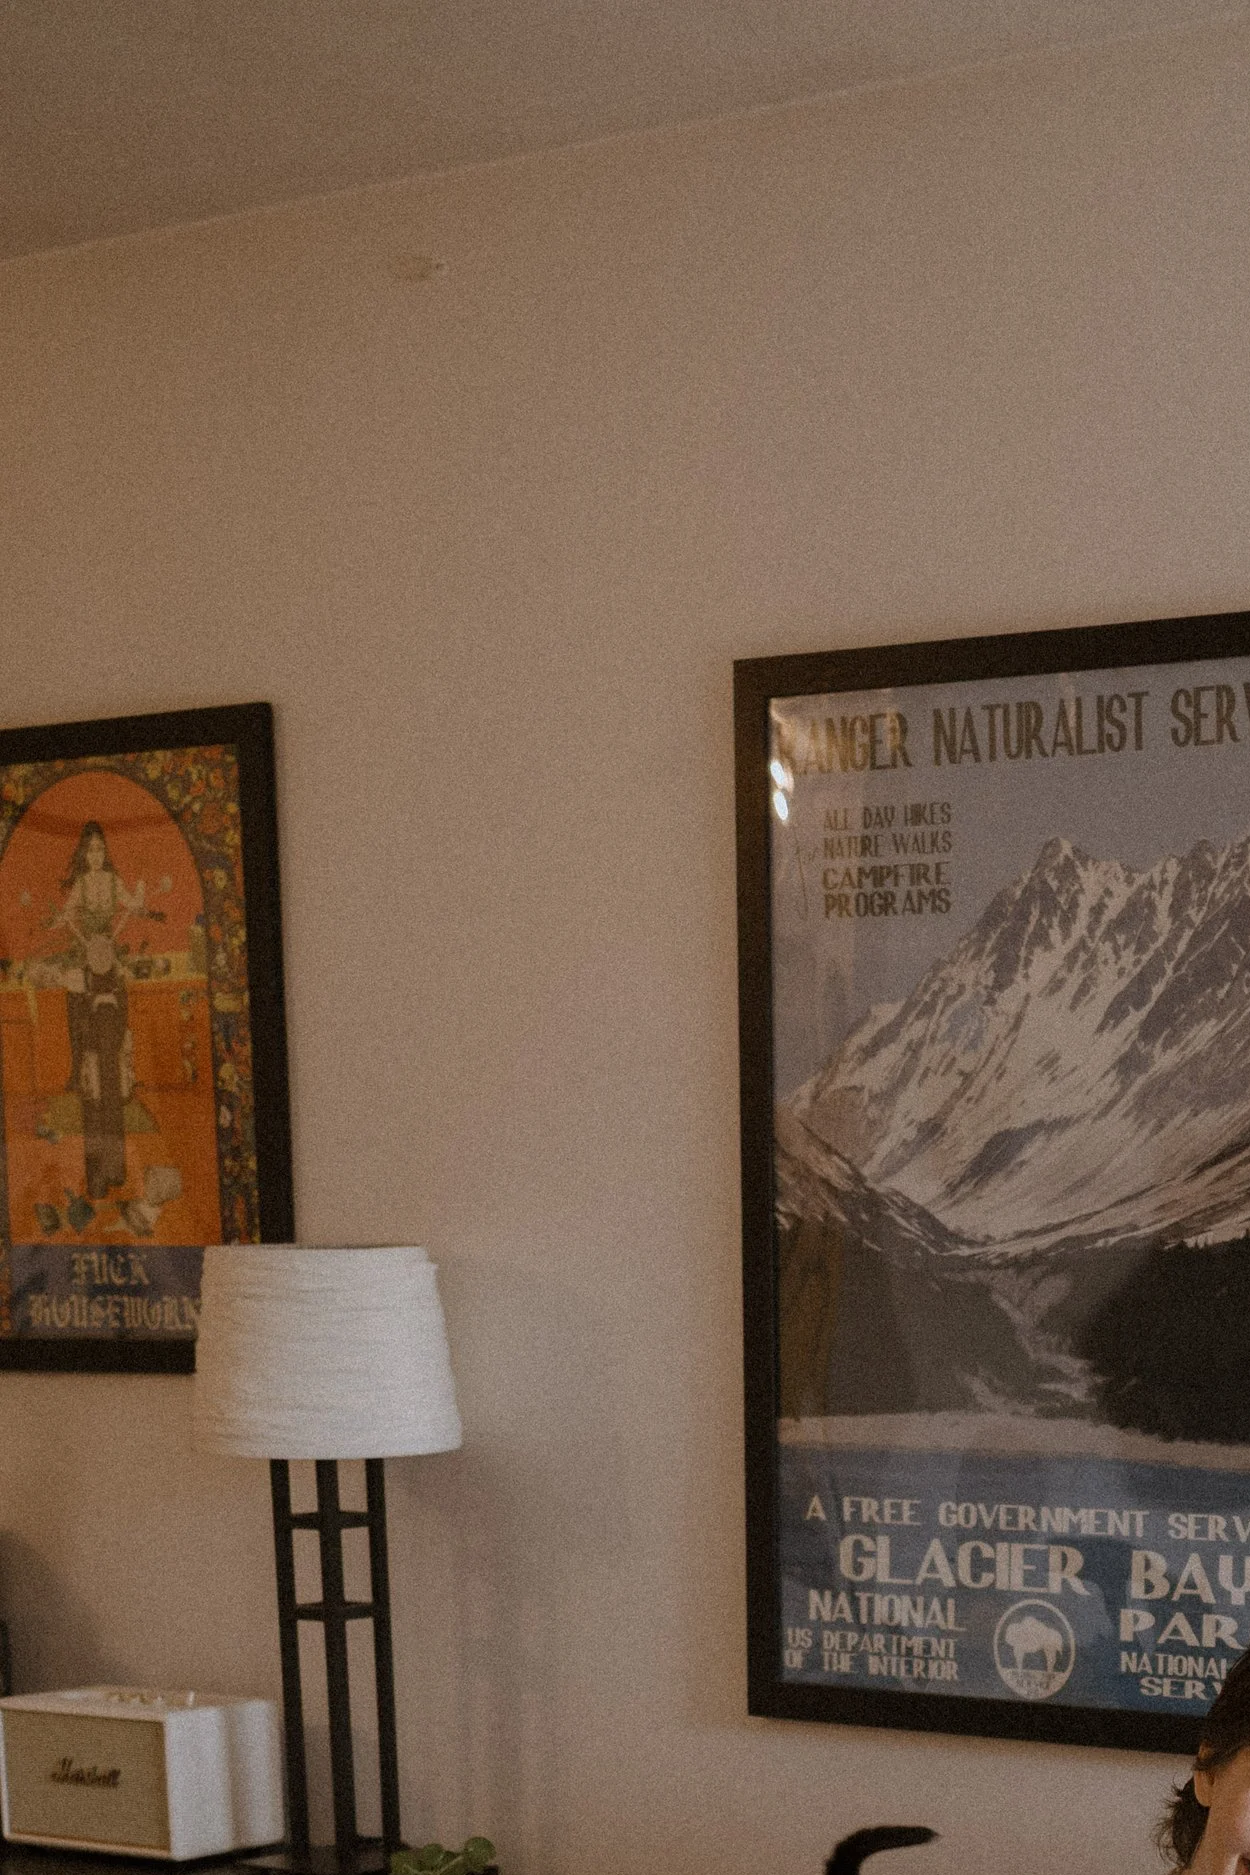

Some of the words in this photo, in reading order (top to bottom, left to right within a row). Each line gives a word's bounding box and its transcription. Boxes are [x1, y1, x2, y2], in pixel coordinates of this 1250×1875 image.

[777, 711, 913, 775] RANGER
[932, 691, 1150, 766] NATURALIST
[824, 808, 853, 832] ALL
[863, 805, 896, 830] DAY
[904, 802, 952, 827] HIKES
[823, 834, 883, 859] NATURE
[892, 831, 953, 855] WALKS
[822, 861, 951, 891] CAMPFIRE
[823, 888, 952, 919] PROGRAMS
[805, 1496, 828, 1521] A
[843, 1497, 922, 1528] FREE
[938, 1502, 1150, 1538] GOVERNMENT
[839, 1534, 1091, 1596] GLACIER
[808, 1589, 967, 1632] NATIONAL
[786, 1627, 813, 1649] US
[822, 1630, 958, 1659] DEPARTMENT
[821, 1652, 858, 1674] THE
[868, 1655, 960, 1682] INTERIOR
